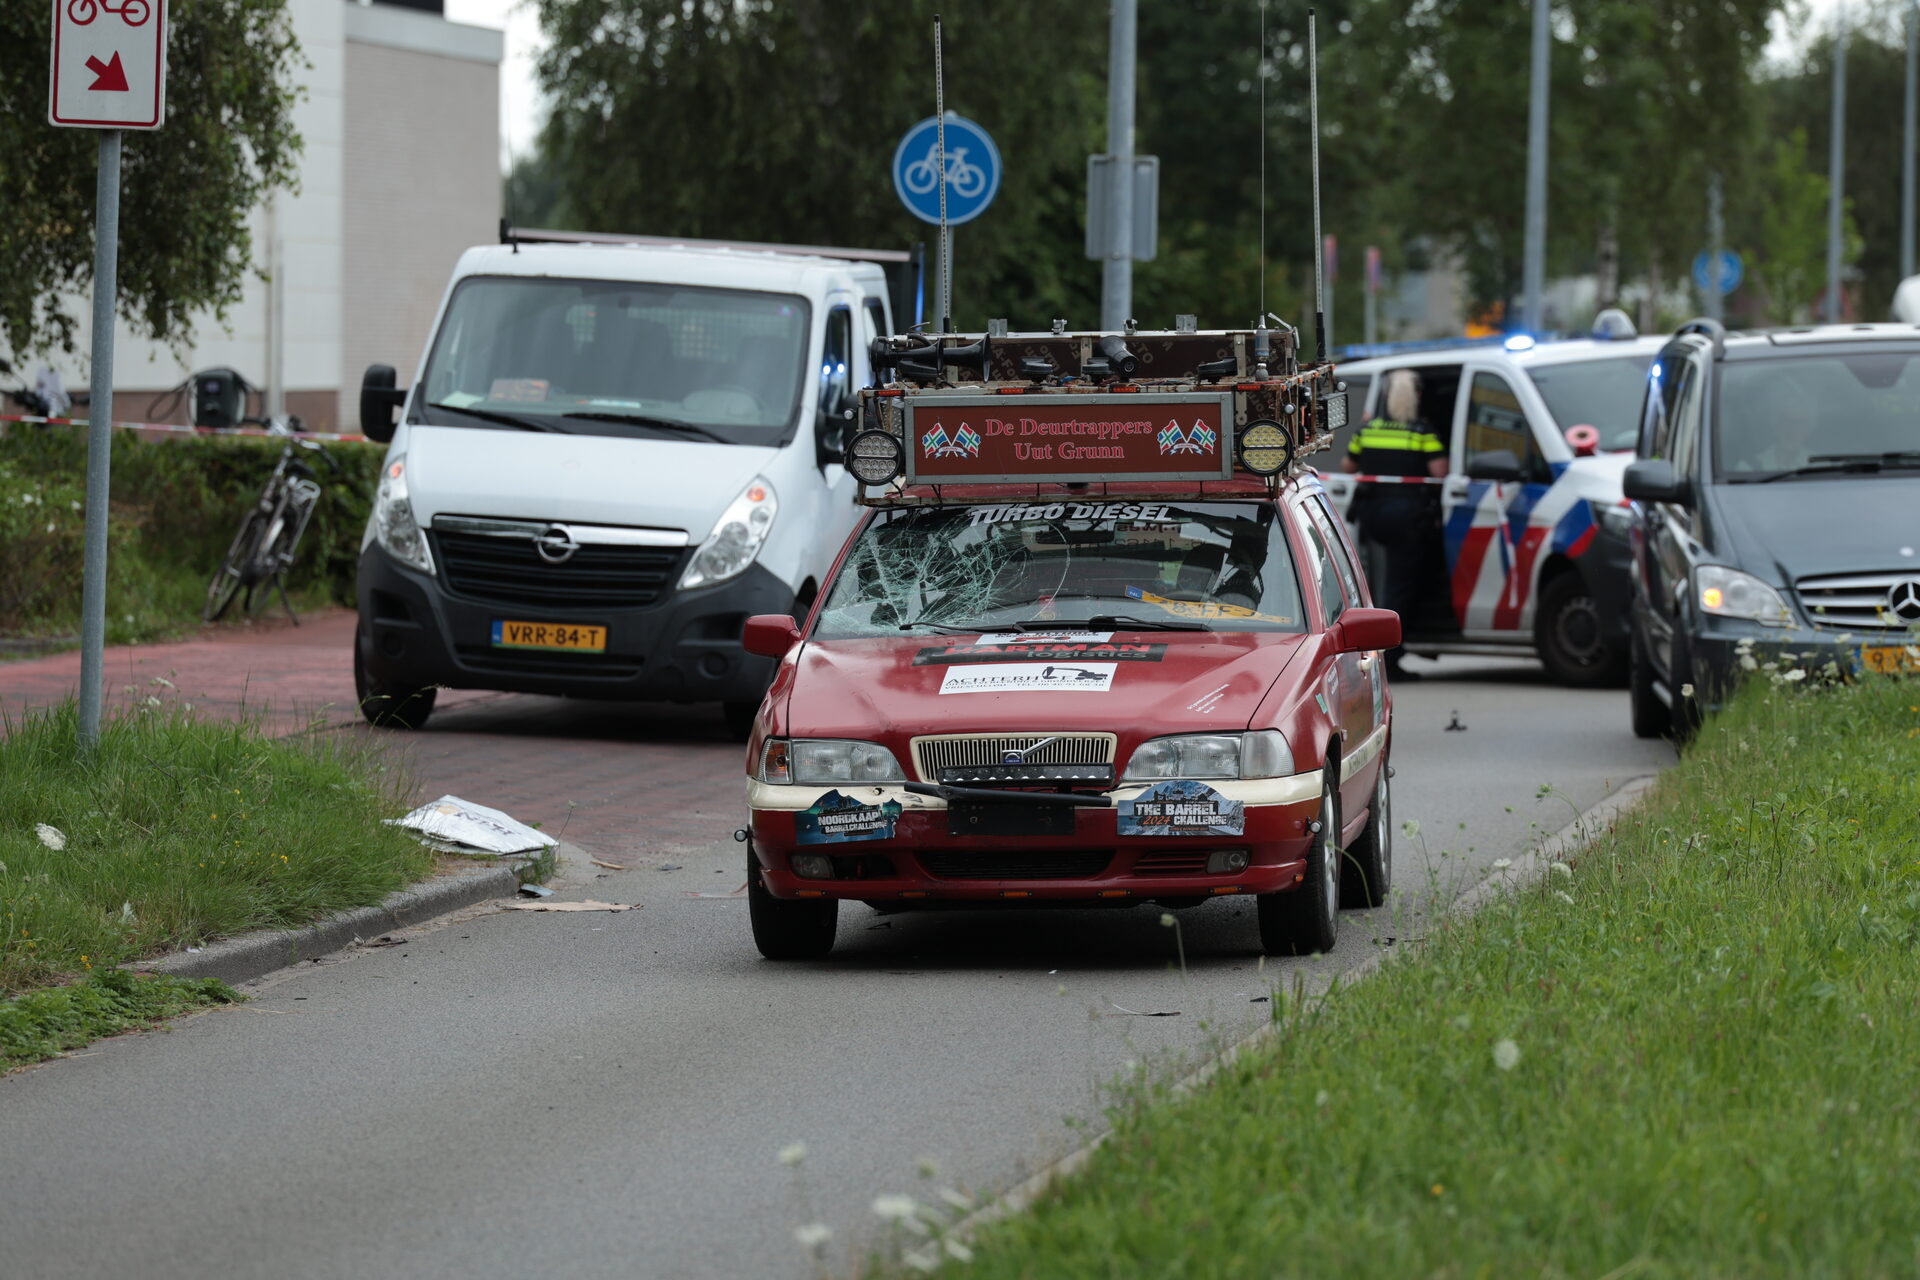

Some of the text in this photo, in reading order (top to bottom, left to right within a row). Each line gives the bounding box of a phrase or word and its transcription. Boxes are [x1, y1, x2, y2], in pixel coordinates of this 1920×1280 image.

[985, 418, 1153, 439] De Deurtrappers
[1014, 441, 1125, 460] Uut Grunn
[970, 503, 1173, 527] TURBO DIESEL
[508, 624, 600, 646] VRR-84-T
[1026, 650, 1147, 659] logistics
[1135, 804, 1217, 815] THE BARREL
[817, 811, 879, 826] NOORDKAAP
[1143, 815, 1227, 825] 2024 CHALLENGE
